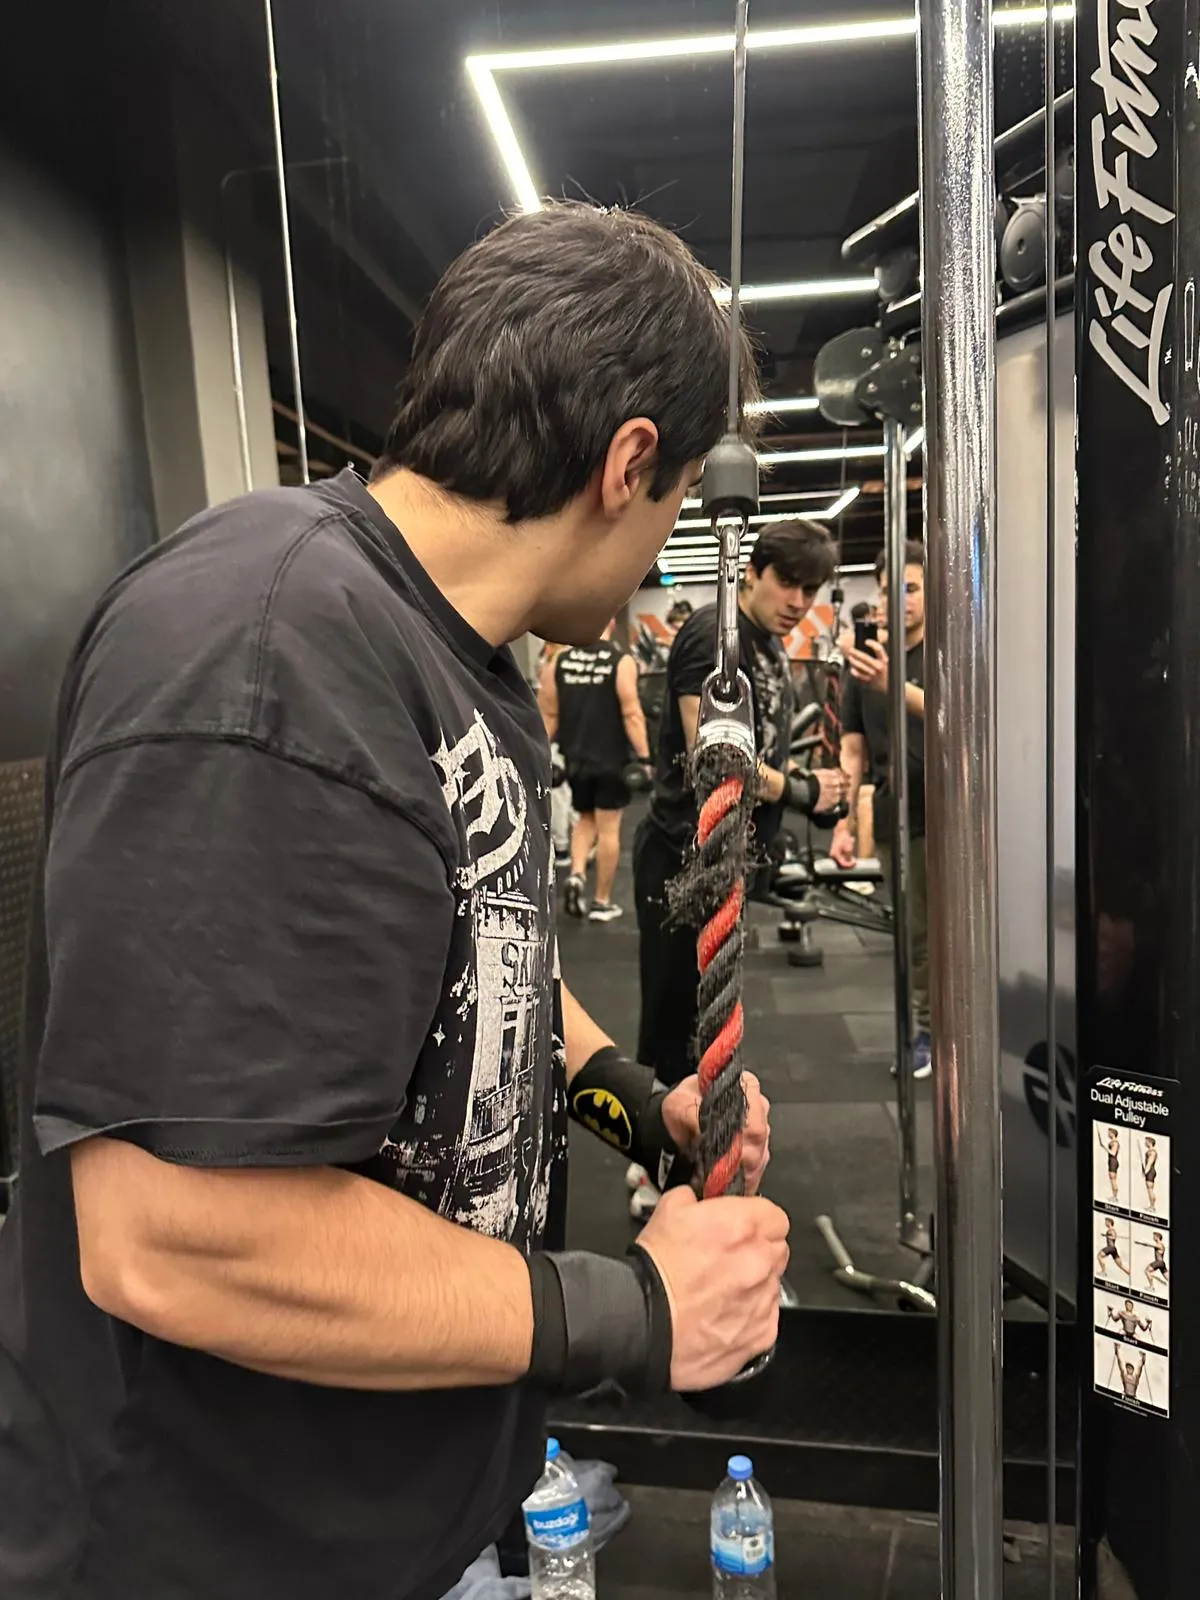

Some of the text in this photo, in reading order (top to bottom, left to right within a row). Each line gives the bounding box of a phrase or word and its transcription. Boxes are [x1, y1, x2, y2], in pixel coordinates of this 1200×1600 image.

[1089, 223, 1174, 426] Life
[1119, 1081, 1164, 1097] Fitness
[1090, 1088, 1169, 1116] Dual Adjustable
[1114, 1107, 1146, 1128] Pulley
